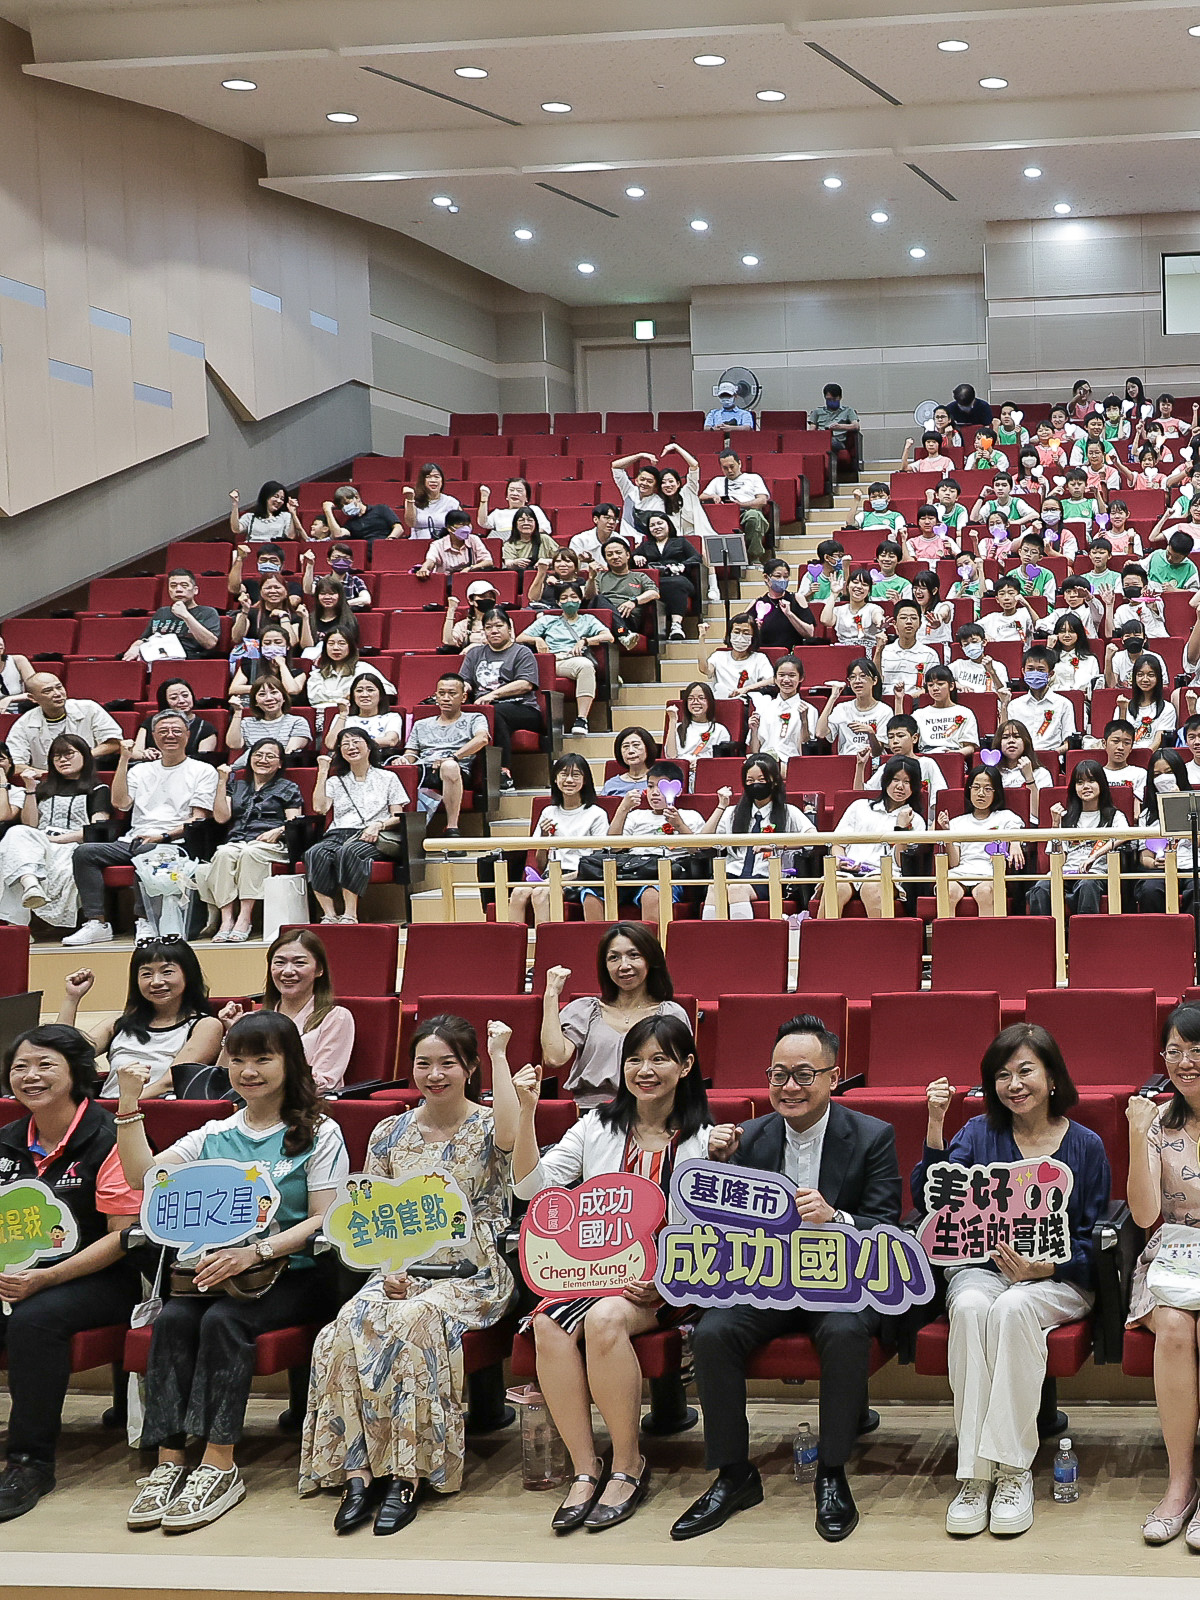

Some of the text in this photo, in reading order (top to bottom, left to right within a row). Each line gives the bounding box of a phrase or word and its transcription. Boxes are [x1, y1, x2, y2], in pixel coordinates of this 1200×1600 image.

[958, 670, 987, 686] CHAMPI
[925, 717, 956, 725] NUMBE
[156, 1186, 253, 1230] 明日之星
[578, 1186, 633, 1217] 成功
[689, 1172, 780, 1214] 基隆市
[928, 1167, 1013, 1213] 美好
[347, 1193, 448, 1248] 全場焦點
[578, 1217, 634, 1248] 國小
[931, 1212, 1067, 1259] 生活的實踐
[539, 1262, 627, 1281] Cheng Kung
[662, 1225, 911, 1292] 成功國小
[562, 1273, 637, 1288] Elementary School
